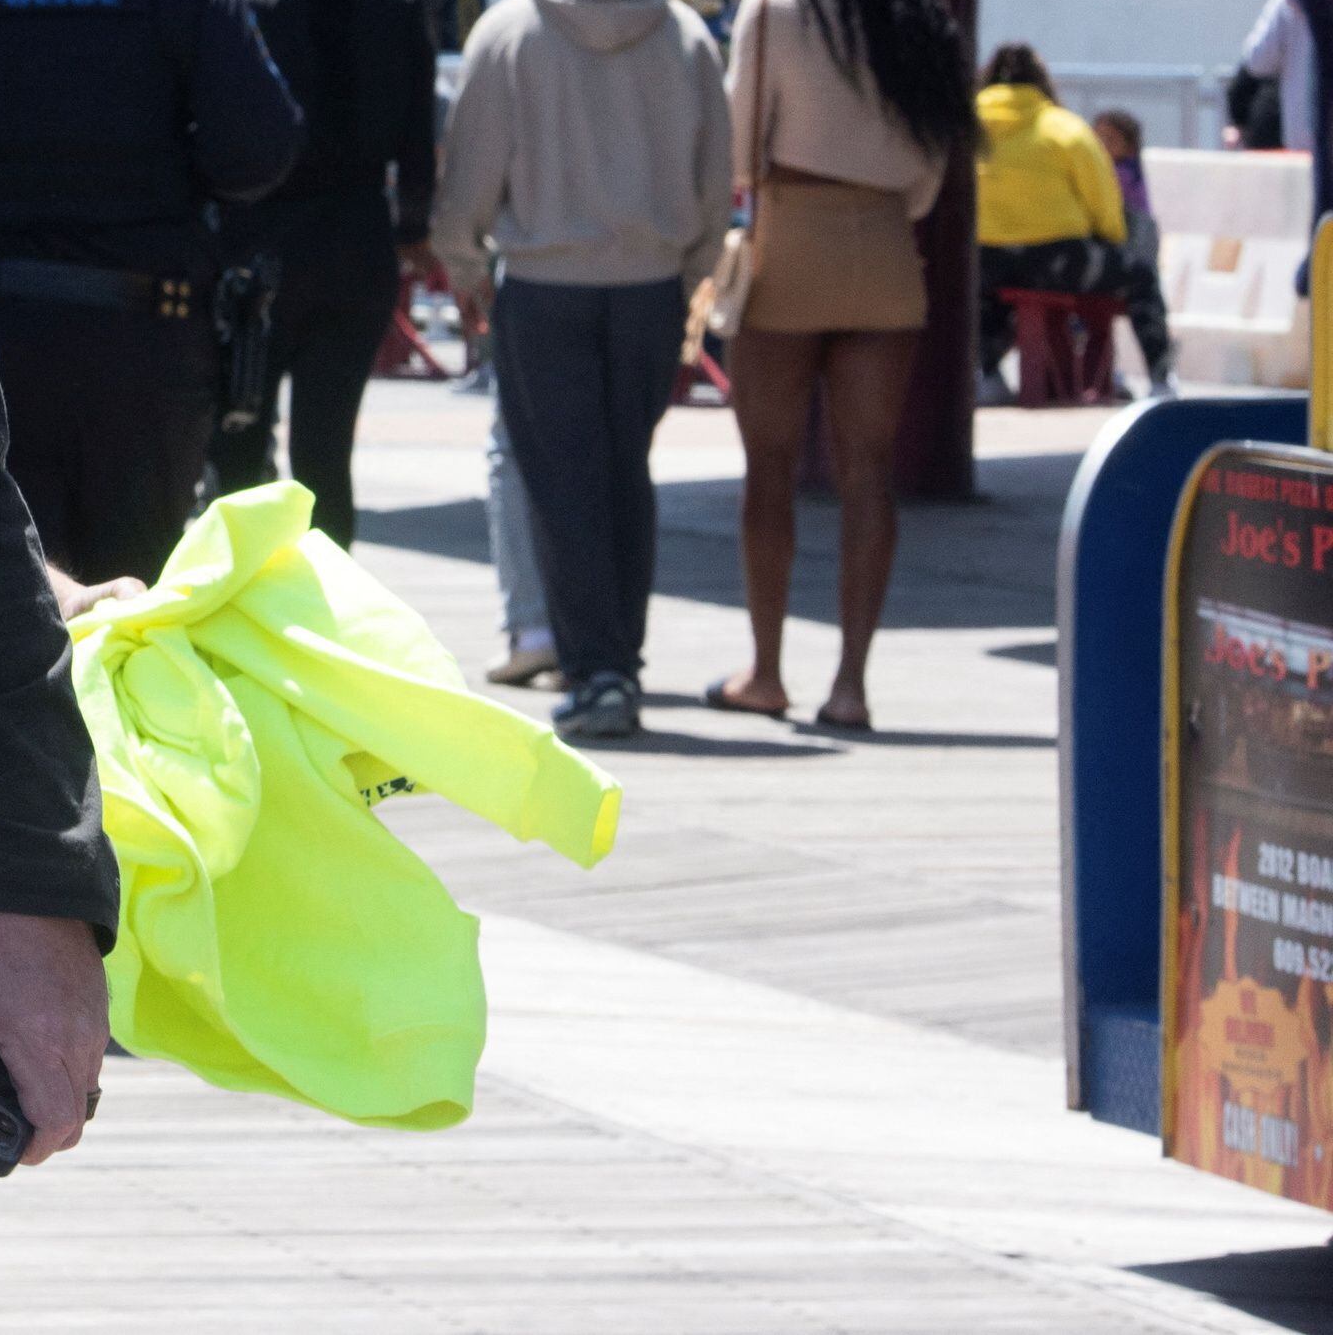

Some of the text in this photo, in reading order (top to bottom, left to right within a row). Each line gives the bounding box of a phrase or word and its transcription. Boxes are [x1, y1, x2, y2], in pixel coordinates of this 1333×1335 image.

[1221, 510, 1301, 568] Joe's
[1204, 623, 1288, 682] Joe's
[1212, 873, 1279, 923] BETWEEN
